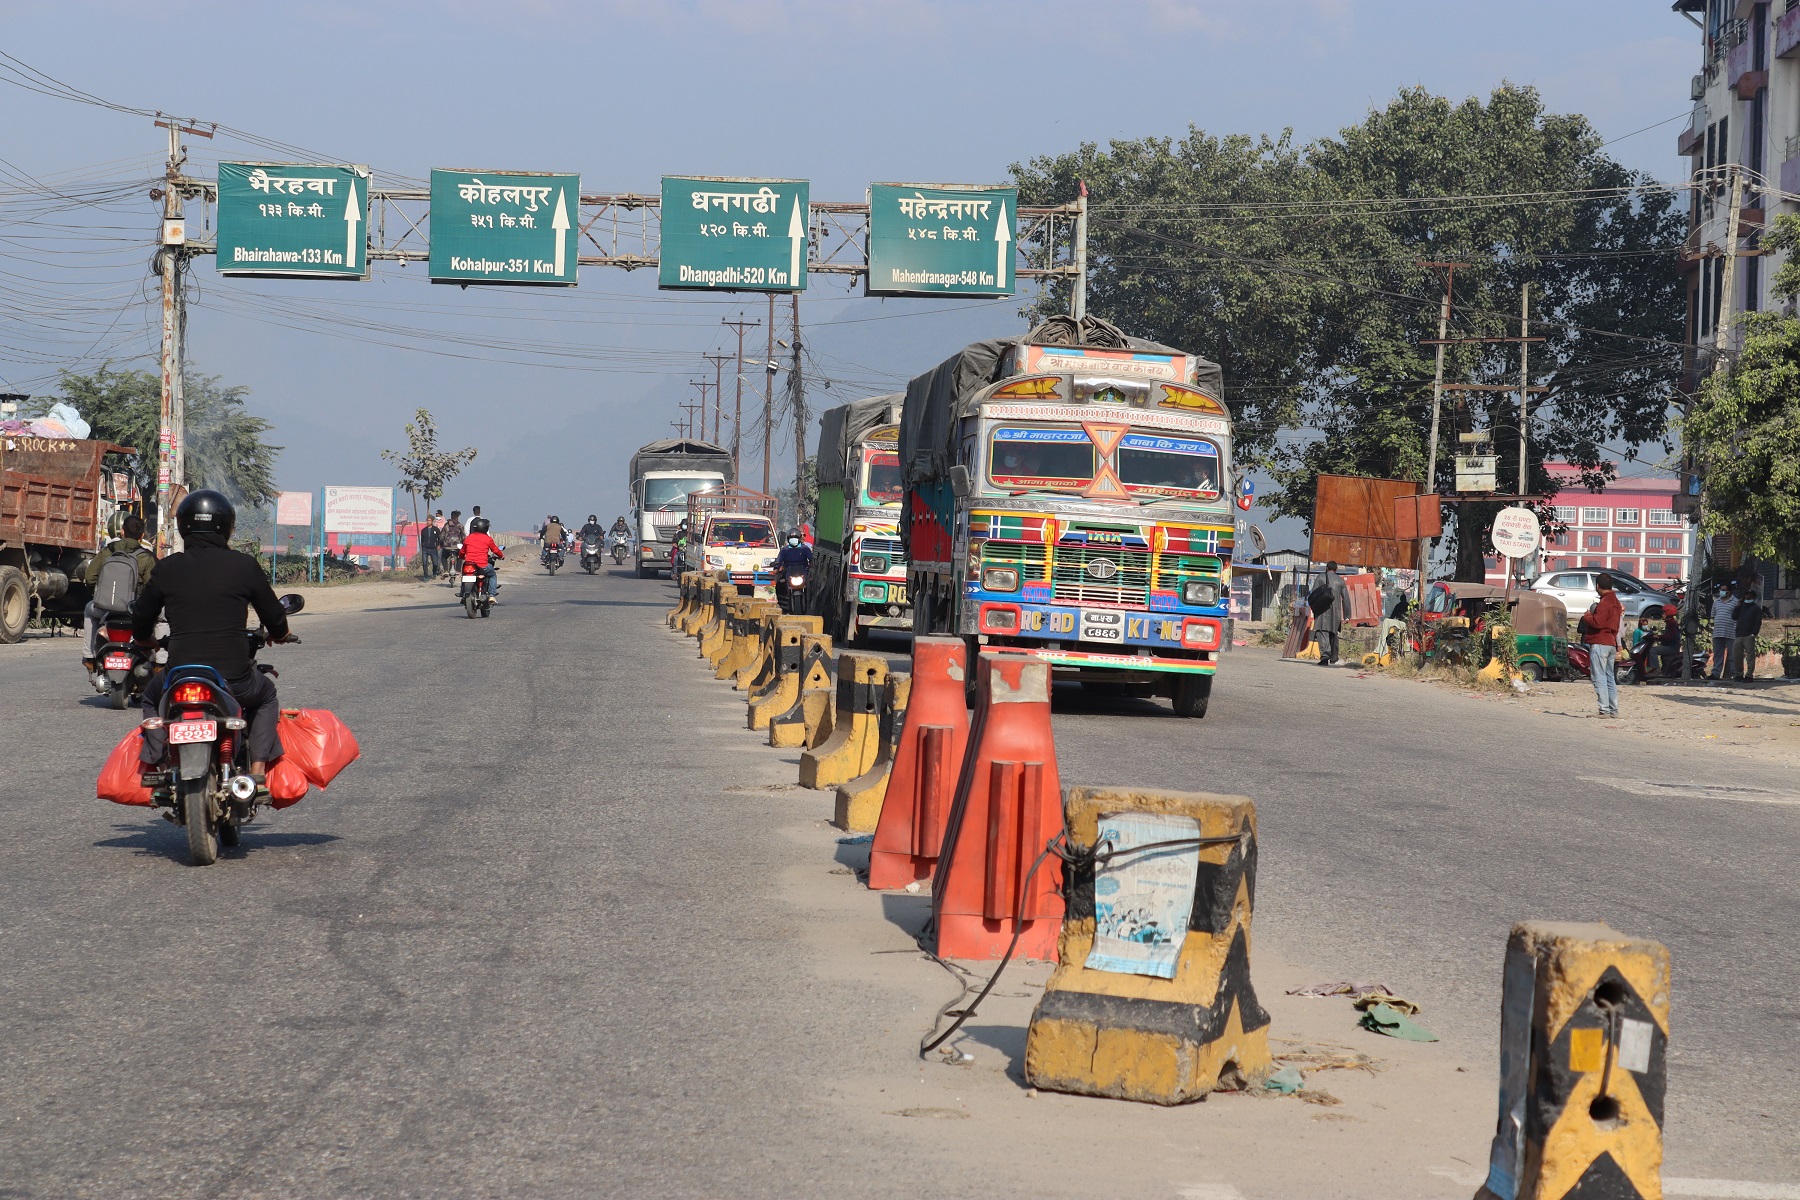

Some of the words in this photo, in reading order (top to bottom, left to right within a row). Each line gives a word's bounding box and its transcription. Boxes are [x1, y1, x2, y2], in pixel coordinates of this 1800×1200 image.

[249, 169, 337, 196] भैरहवा
[458, 178, 553, 211] कोहलपुर
[691, 186, 780, 214] धनगढी
[258, 203, 283, 218] १३३
[288, 202, 325, 218] कि.मी.
[899, 192, 992, 221] महेन्द्रनगर
[470, 213, 493, 229] ३५१
[500, 213, 537, 229] कि.मी.
[700, 223, 727, 238] ५२०
[733, 222, 770, 239] कि.मी.
[908, 227, 937, 241] ५४८
[943, 227, 980, 243] कि.मी.
[234, 247, 322, 264] Bhairahawa-133
[324, 249, 342, 265] Km
[451, 257, 531, 275] Kohalpur-351
[533, 260, 554, 274] Km
[679, 265, 765, 287] Dhangadhi-520
[768, 269, 787, 285] Km
[892, 268, 977, 288] Mahendranagar-548
[979, 272, 994, 287] Km
[21, 436, 57, 453] ROCK
[1012, 431, 1029, 440] श्री
[1129, 438, 1156, 447] बाबा
[1175, 442, 1200, 451] जय
[1086, 530, 1122, 543] TATA
[888, 584, 907, 603] RO
[1021, 610, 1075, 633] ROAD
[1128, 617, 1183, 641] KING
